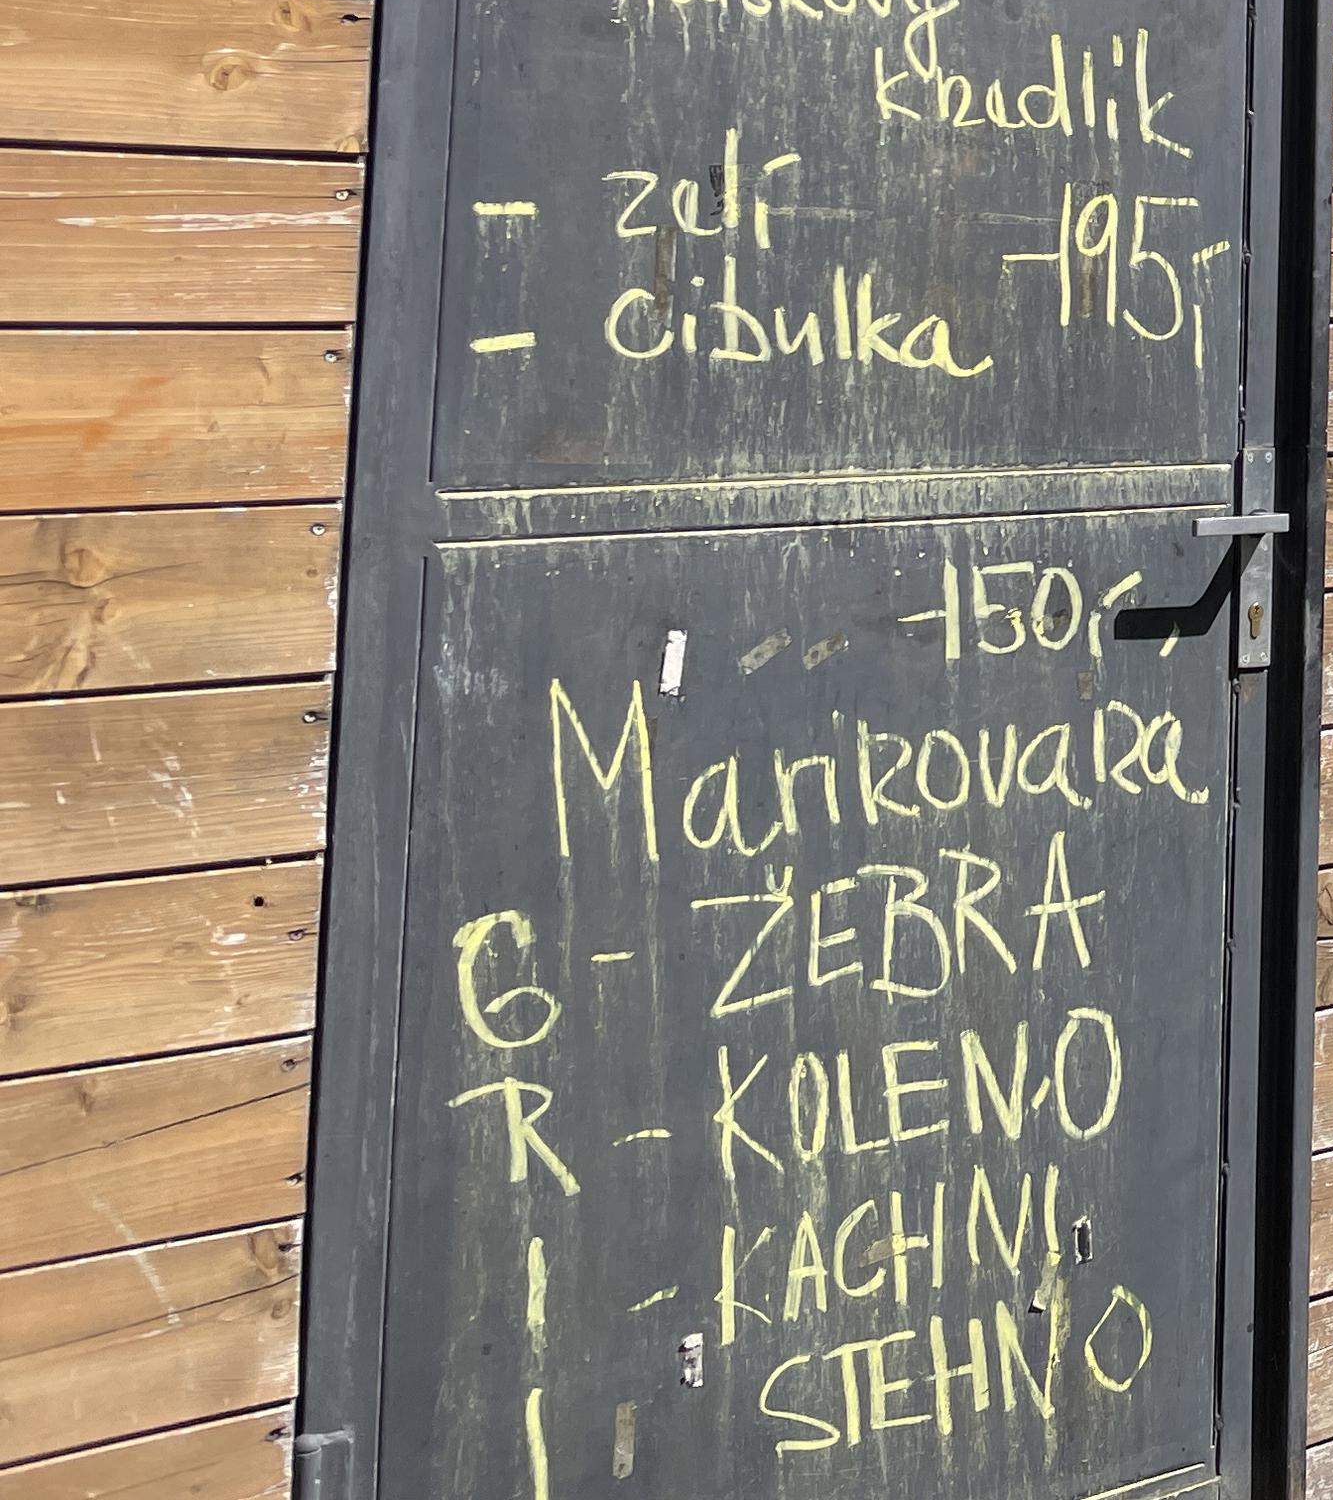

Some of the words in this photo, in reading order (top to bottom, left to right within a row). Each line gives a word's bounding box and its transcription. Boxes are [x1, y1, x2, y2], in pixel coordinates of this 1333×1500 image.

[690, 832, 1106, 1018] ŽEBRA
[714, 1008, 1121, 1180] KOLENO
[760, 1285, 1152, 1457] STEHNO
